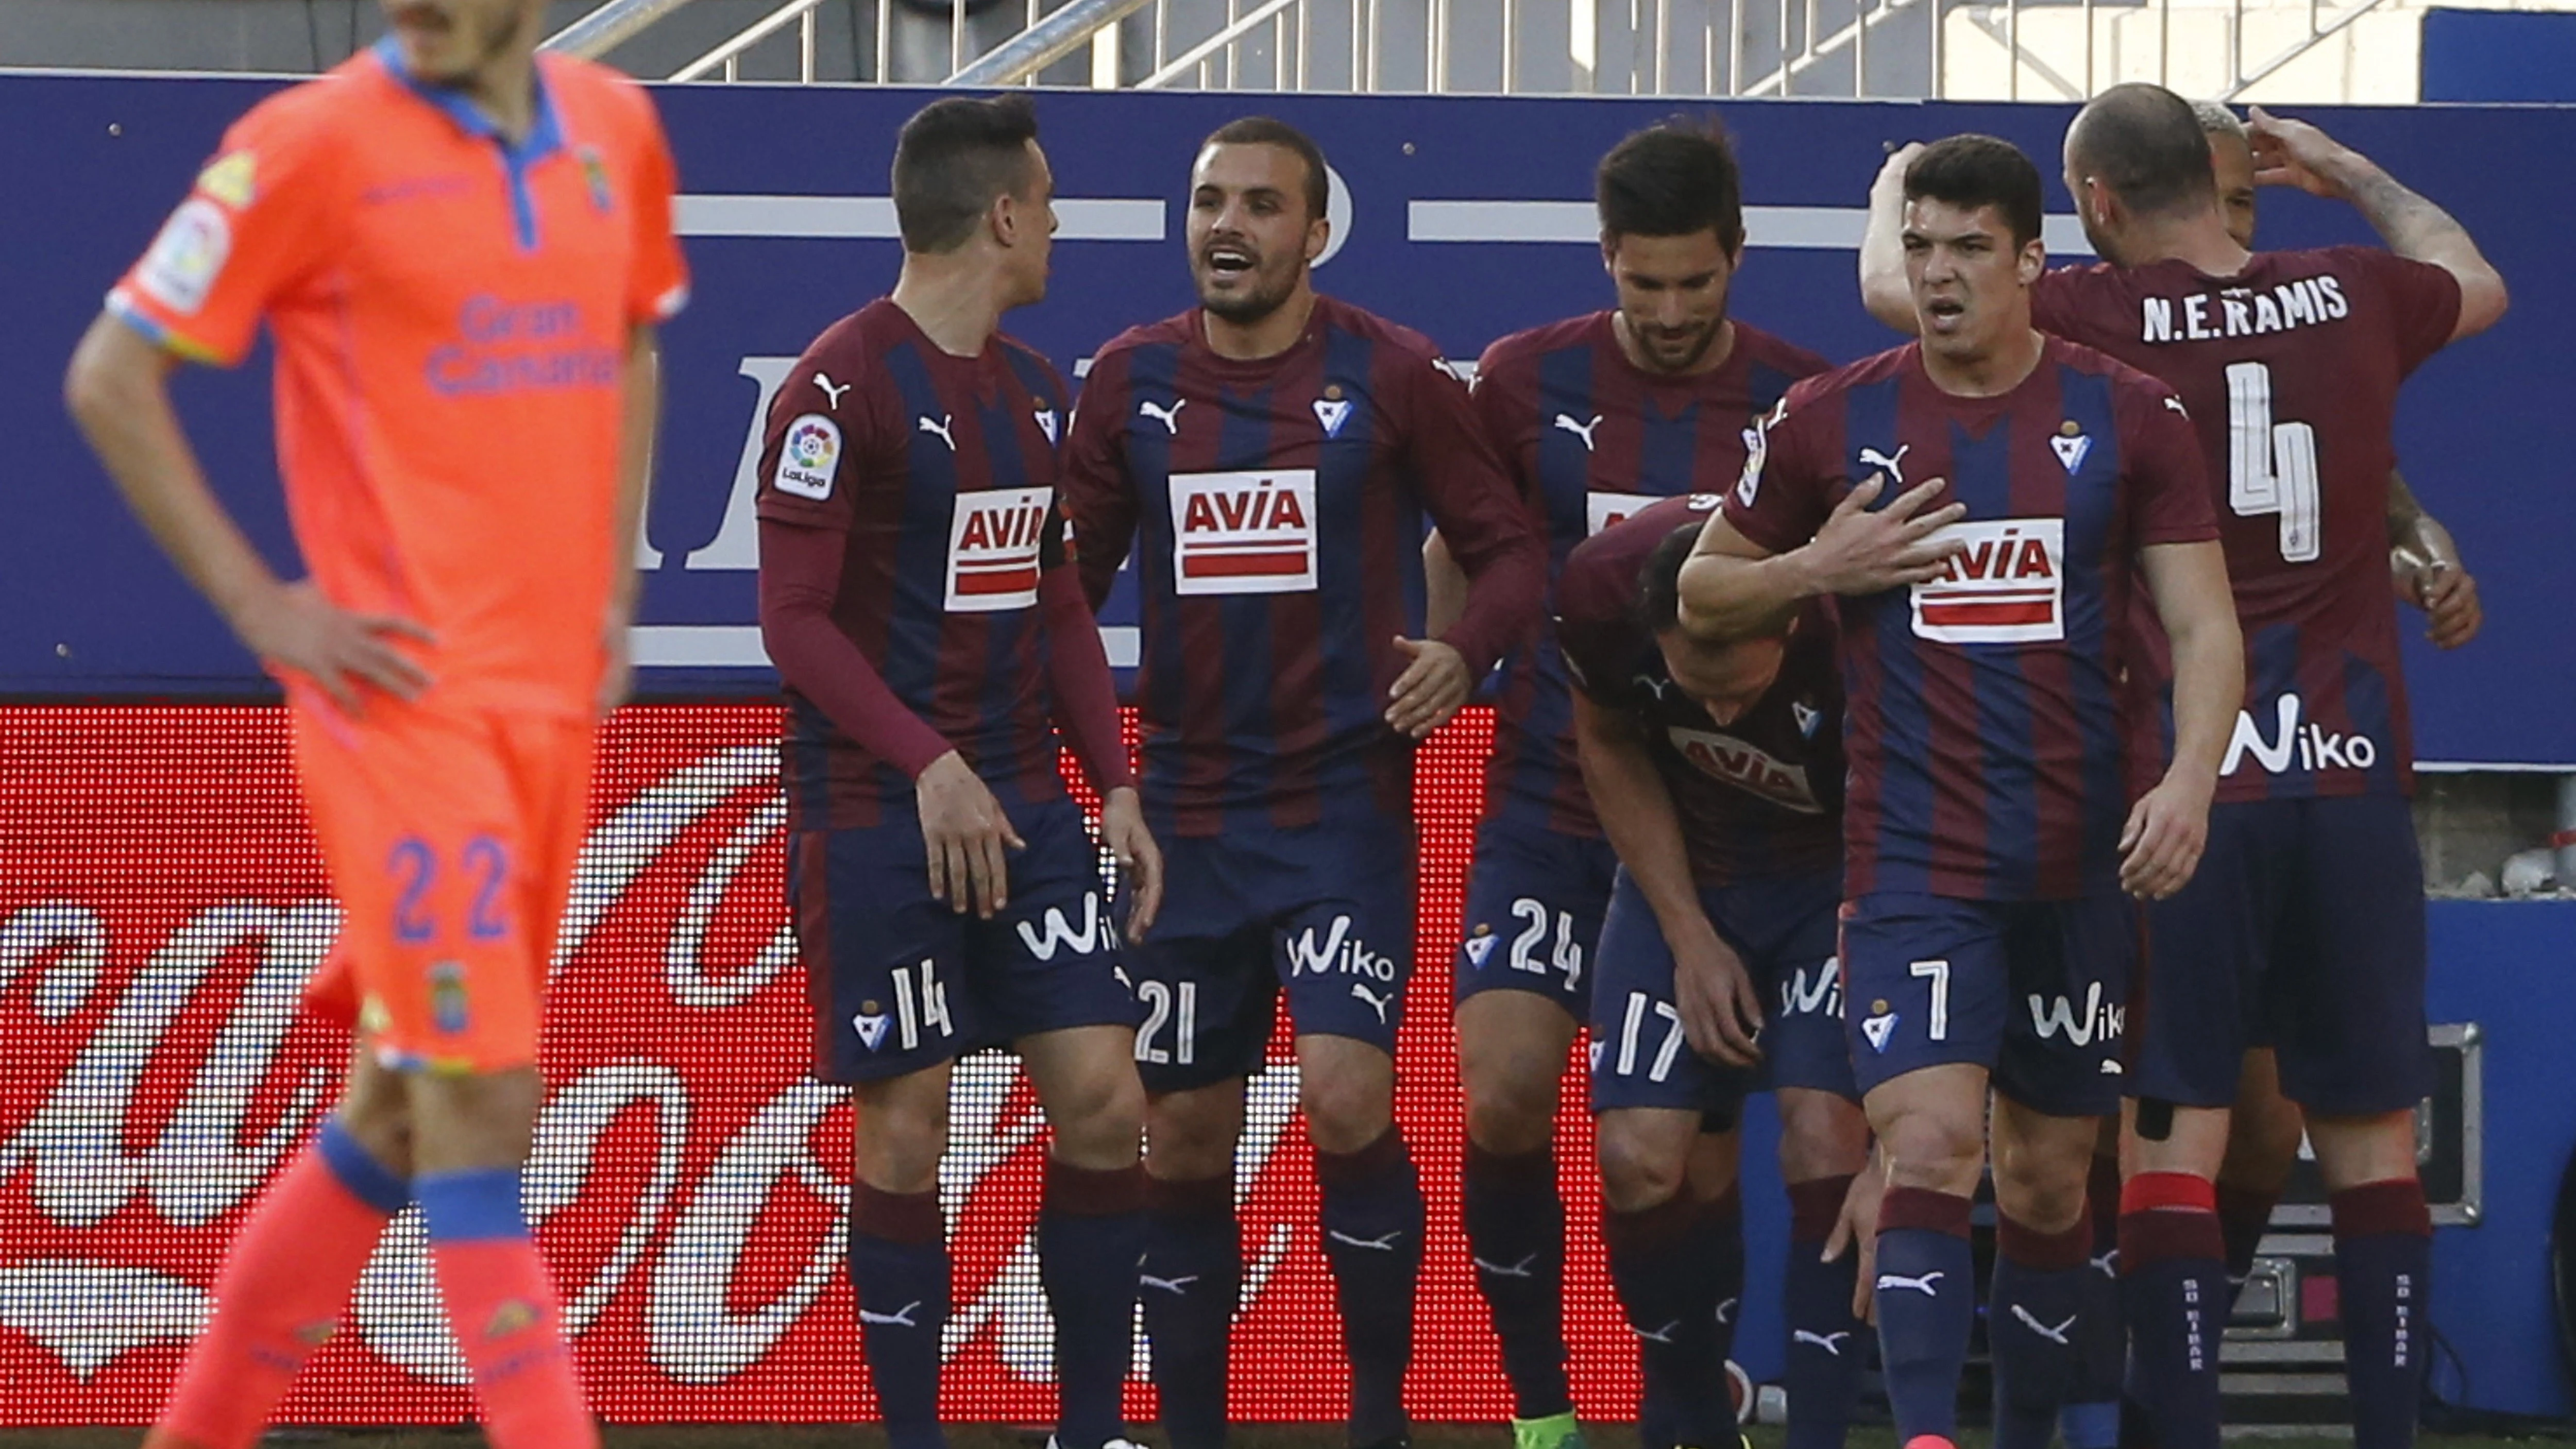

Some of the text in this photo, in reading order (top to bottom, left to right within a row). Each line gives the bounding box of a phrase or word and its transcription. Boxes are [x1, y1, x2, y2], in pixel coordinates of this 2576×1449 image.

[2142, 276, 2348, 343] N.E.RAMIS
[2225, 362, 2319, 562] 4
[1287, 915, 1395, 981] Wiko
[1510, 898, 1582, 991] 24
[891, 959, 954, 1050] 14
[1134, 981, 1196, 1064] 21
[1617, 992, 1684, 1082] 17
[1910, 960, 1949, 1041] 7
